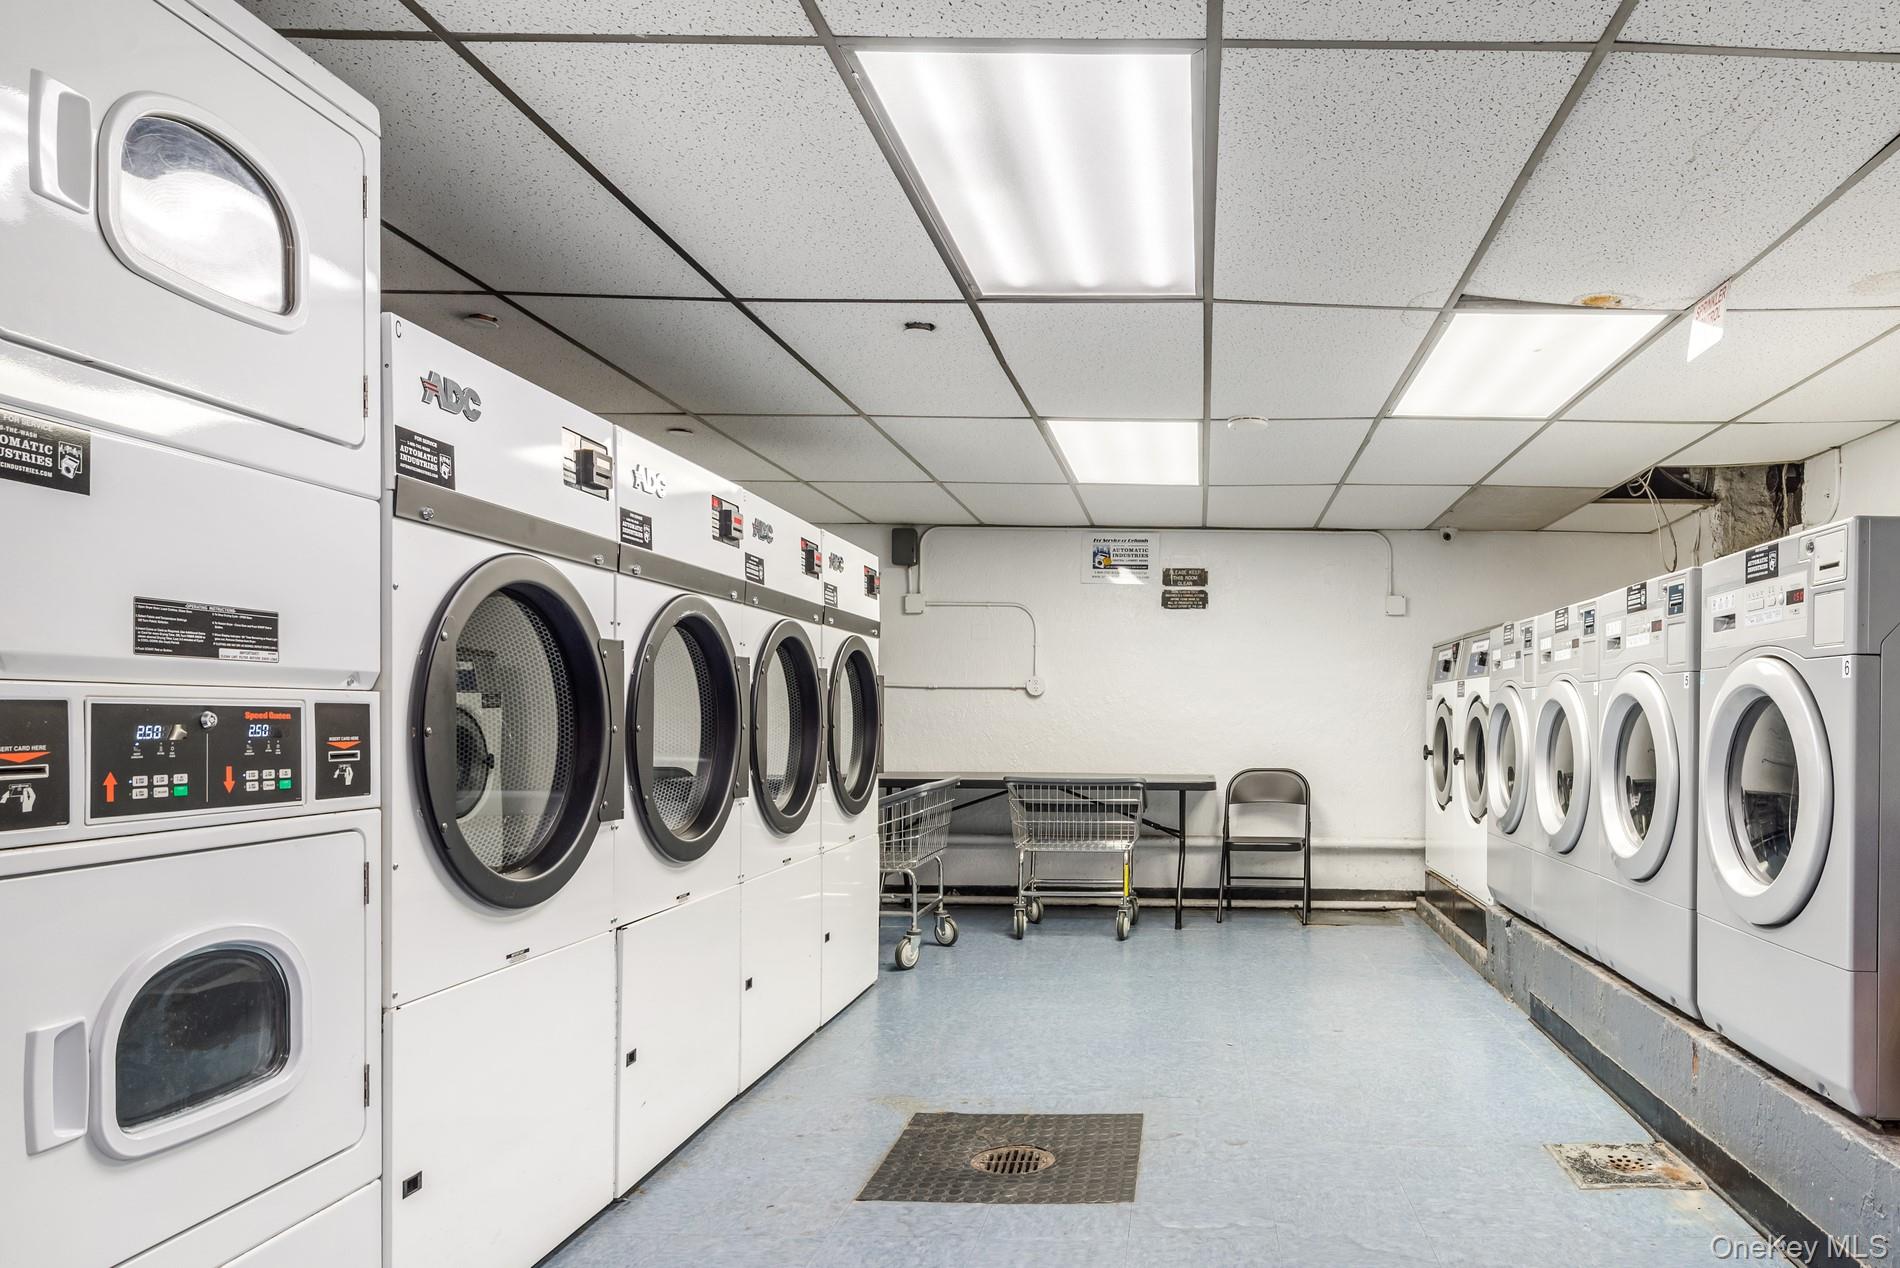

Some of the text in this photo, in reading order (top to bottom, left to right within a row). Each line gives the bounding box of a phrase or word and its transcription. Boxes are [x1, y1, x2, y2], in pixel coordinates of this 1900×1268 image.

[420, 370, 482, 422] ADC
[400, 444, 438, 463] AUTOMATIC
[400, 452, 439, 472] INDUSTRIES
[1844, 660, 1850, 676] 6
[244, 711, 268, 720] Speed
